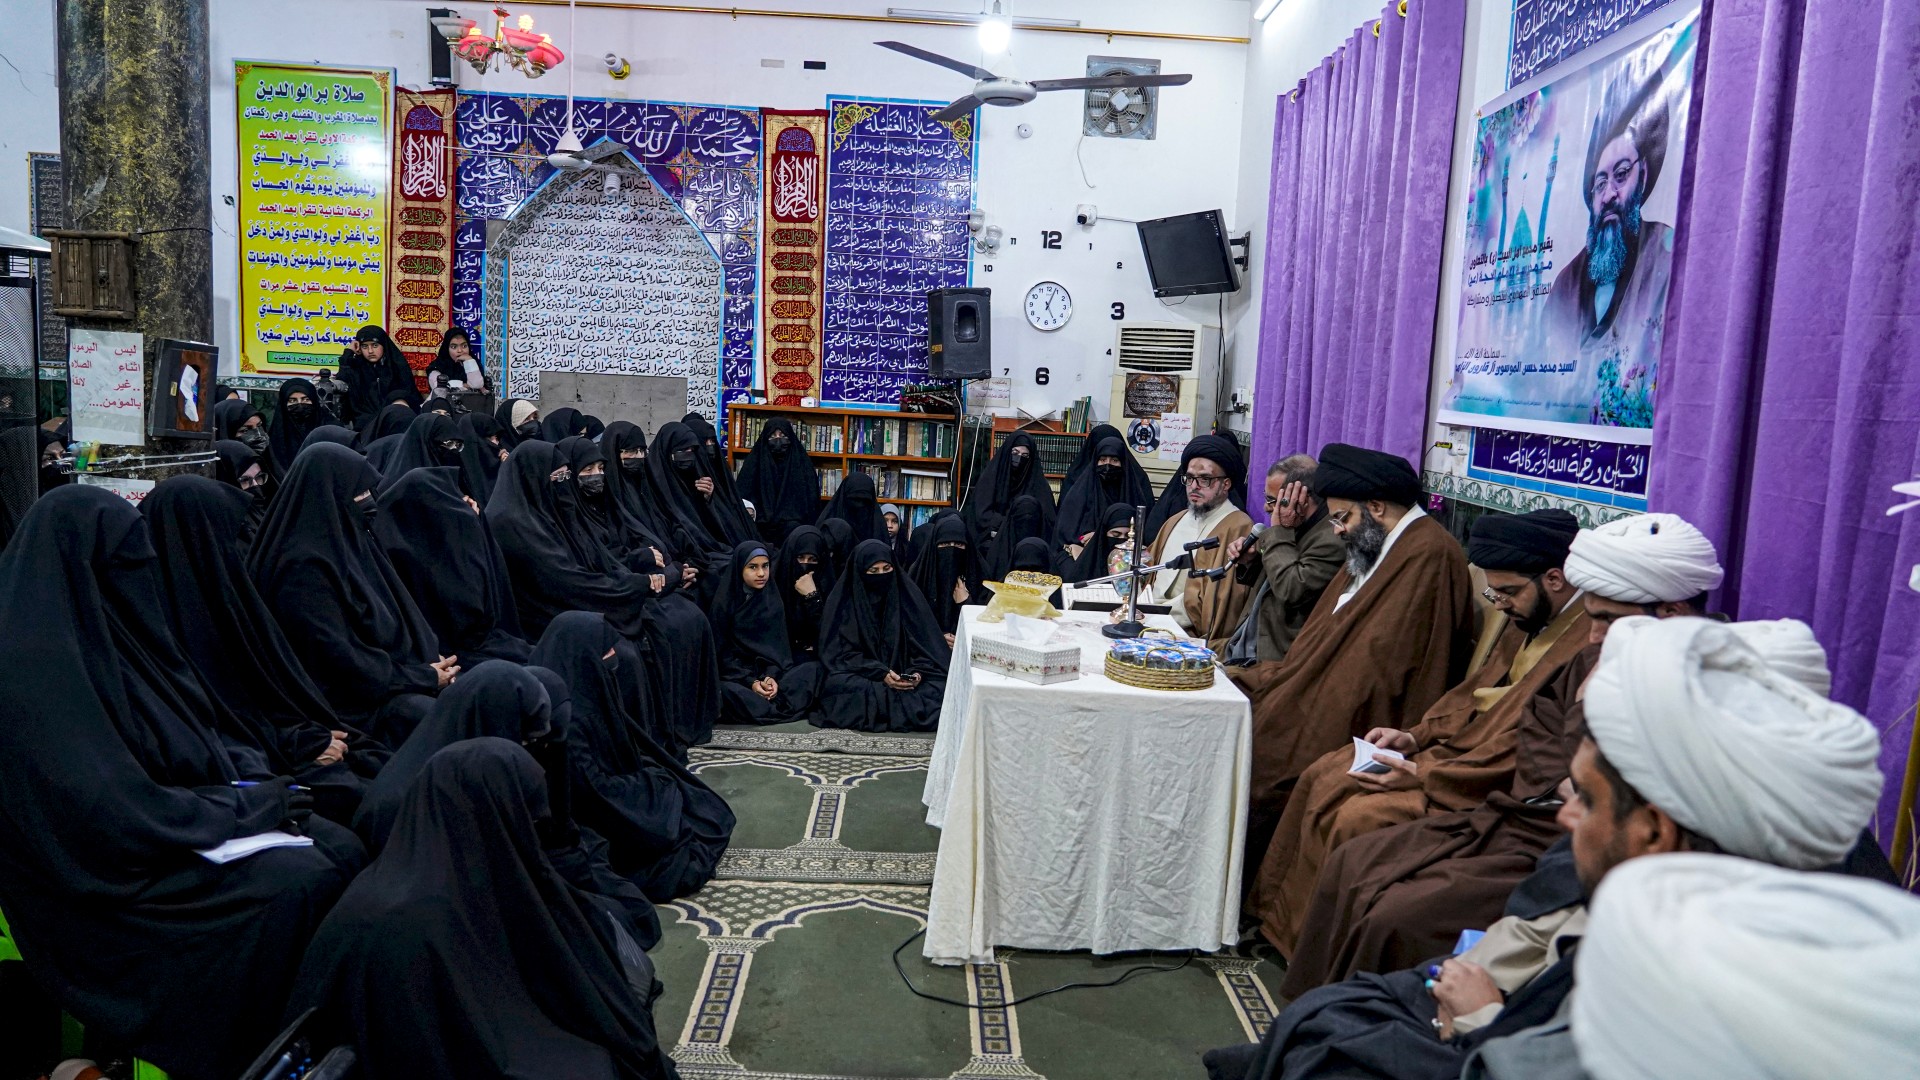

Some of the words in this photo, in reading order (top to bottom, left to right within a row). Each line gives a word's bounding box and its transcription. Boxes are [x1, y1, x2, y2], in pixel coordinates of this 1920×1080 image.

[333, 84, 365, 102] صلاة
[259, 130, 282, 141] الحمد
[283, 132, 298, 143] بعد
[259, 202, 281, 213] الحمد
[283, 204, 298, 215] بعد
[456, 228, 482, 248] علي
[1010, 237, 1017, 245] 11
[1041, 230, 1062, 250] 12
[1089, 242, 1093, 251] 1
[983, 264, 993, 273] 10
[1116, 261, 1123, 269] 2
[260, 279, 280, 291] مرات
[281, 279, 298, 293] عشر
[353, 285, 368, 297] بعد
[1110, 301, 1125, 320] 3
[1106, 348, 1112, 356] 4
[1003, 367, 1010, 376] 7
[1035, 366, 1050, 386] 6
